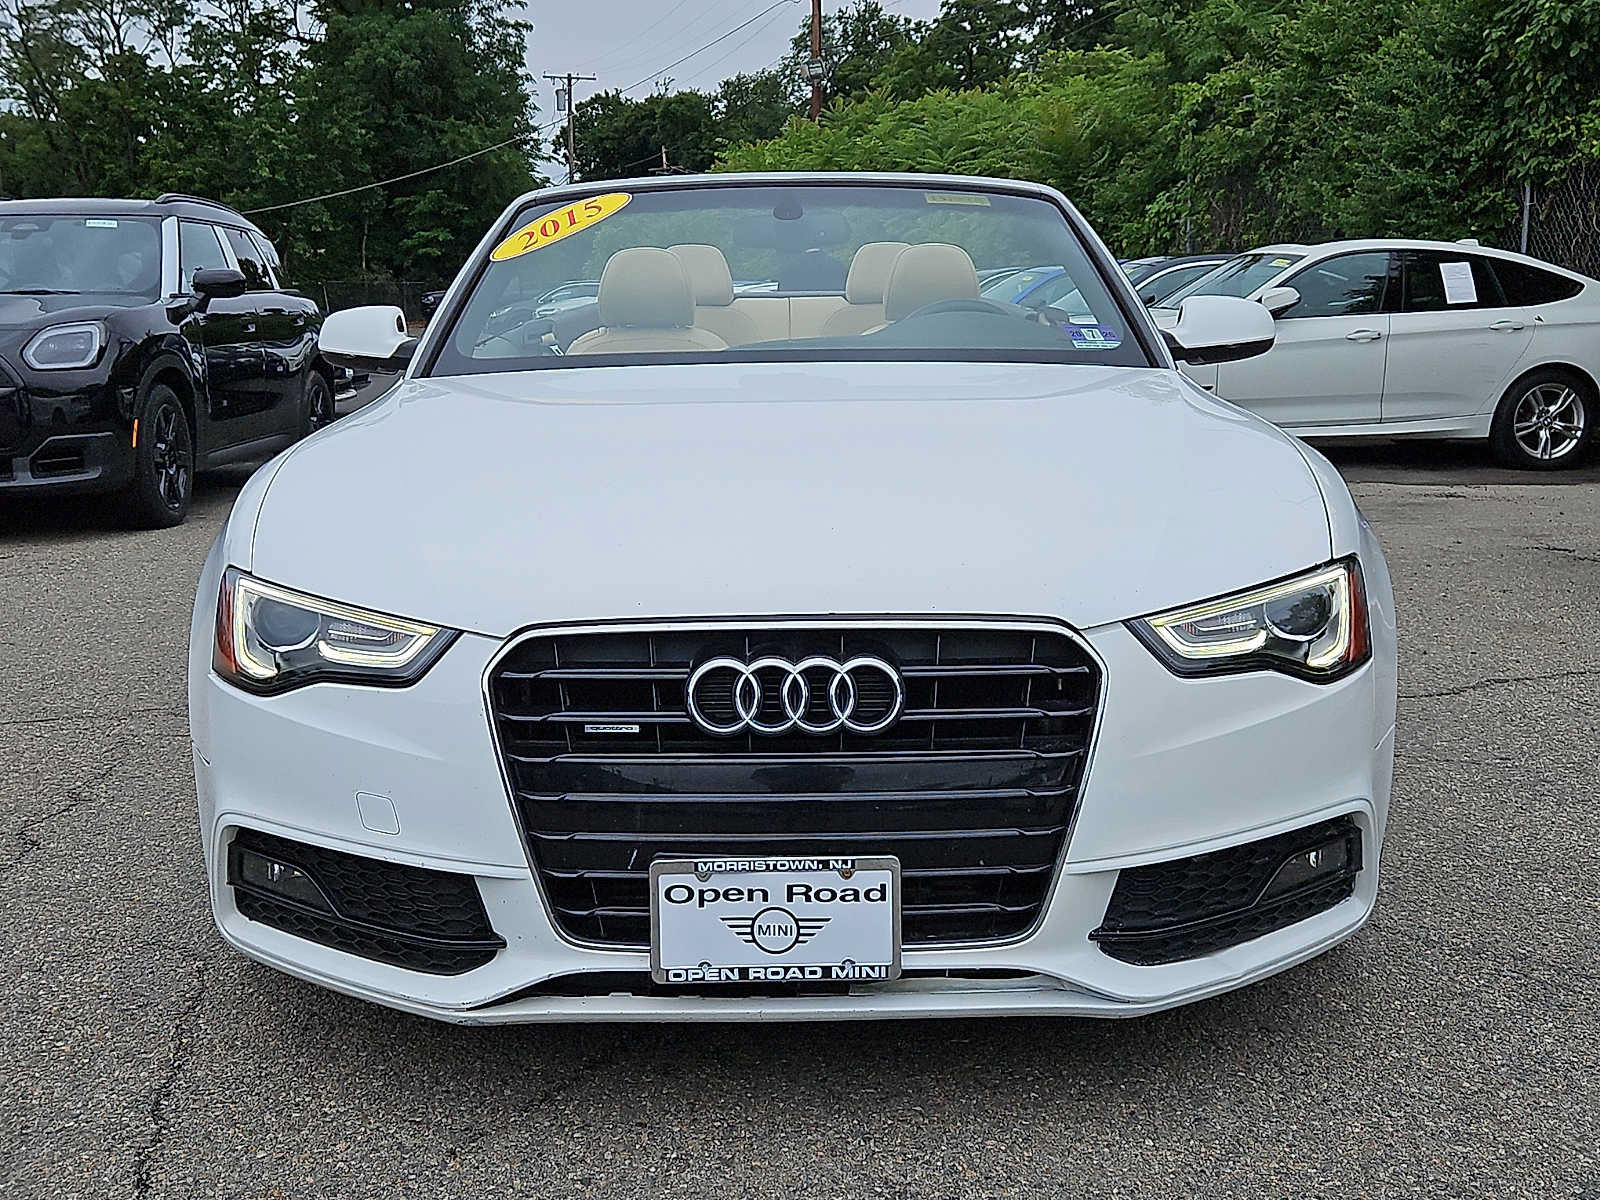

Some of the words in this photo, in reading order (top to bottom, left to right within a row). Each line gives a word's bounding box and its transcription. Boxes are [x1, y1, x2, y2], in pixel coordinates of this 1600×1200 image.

[517, 199, 603, 251] 2015
[1087, 329, 1096, 339] 7
[697, 860, 823, 873] MORRISTOWN,
[829, 860, 852, 870] NJ
[664, 884, 769, 909] Open
[786, 883, 888, 903] Road
[757, 924, 793, 937] MINI
[668, 967, 740, 982] OPEN
[749, 966, 823, 981] ROAD
[831, 965, 888, 979] MINI
